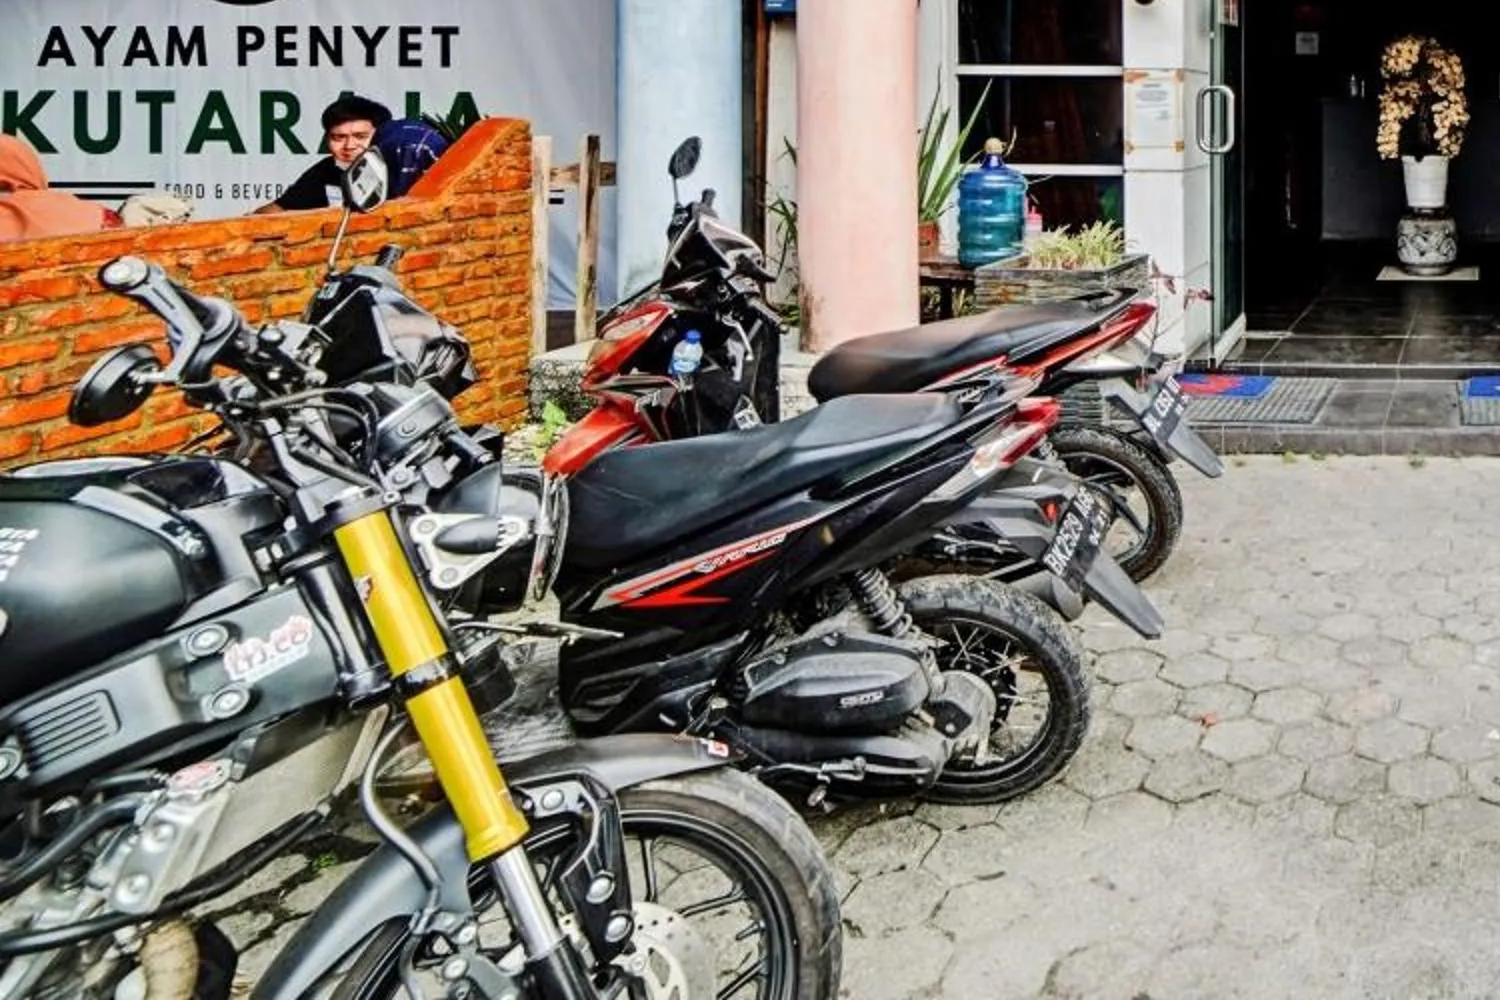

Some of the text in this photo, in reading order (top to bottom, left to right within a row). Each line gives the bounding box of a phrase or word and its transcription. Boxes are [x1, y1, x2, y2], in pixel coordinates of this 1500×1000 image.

[37, 25, 460, 68] AYAM PENYET
[1, 89, 482, 154] KUTARA
[214, 183, 223, 199] &
[231, 183, 288, 199] BEVER
